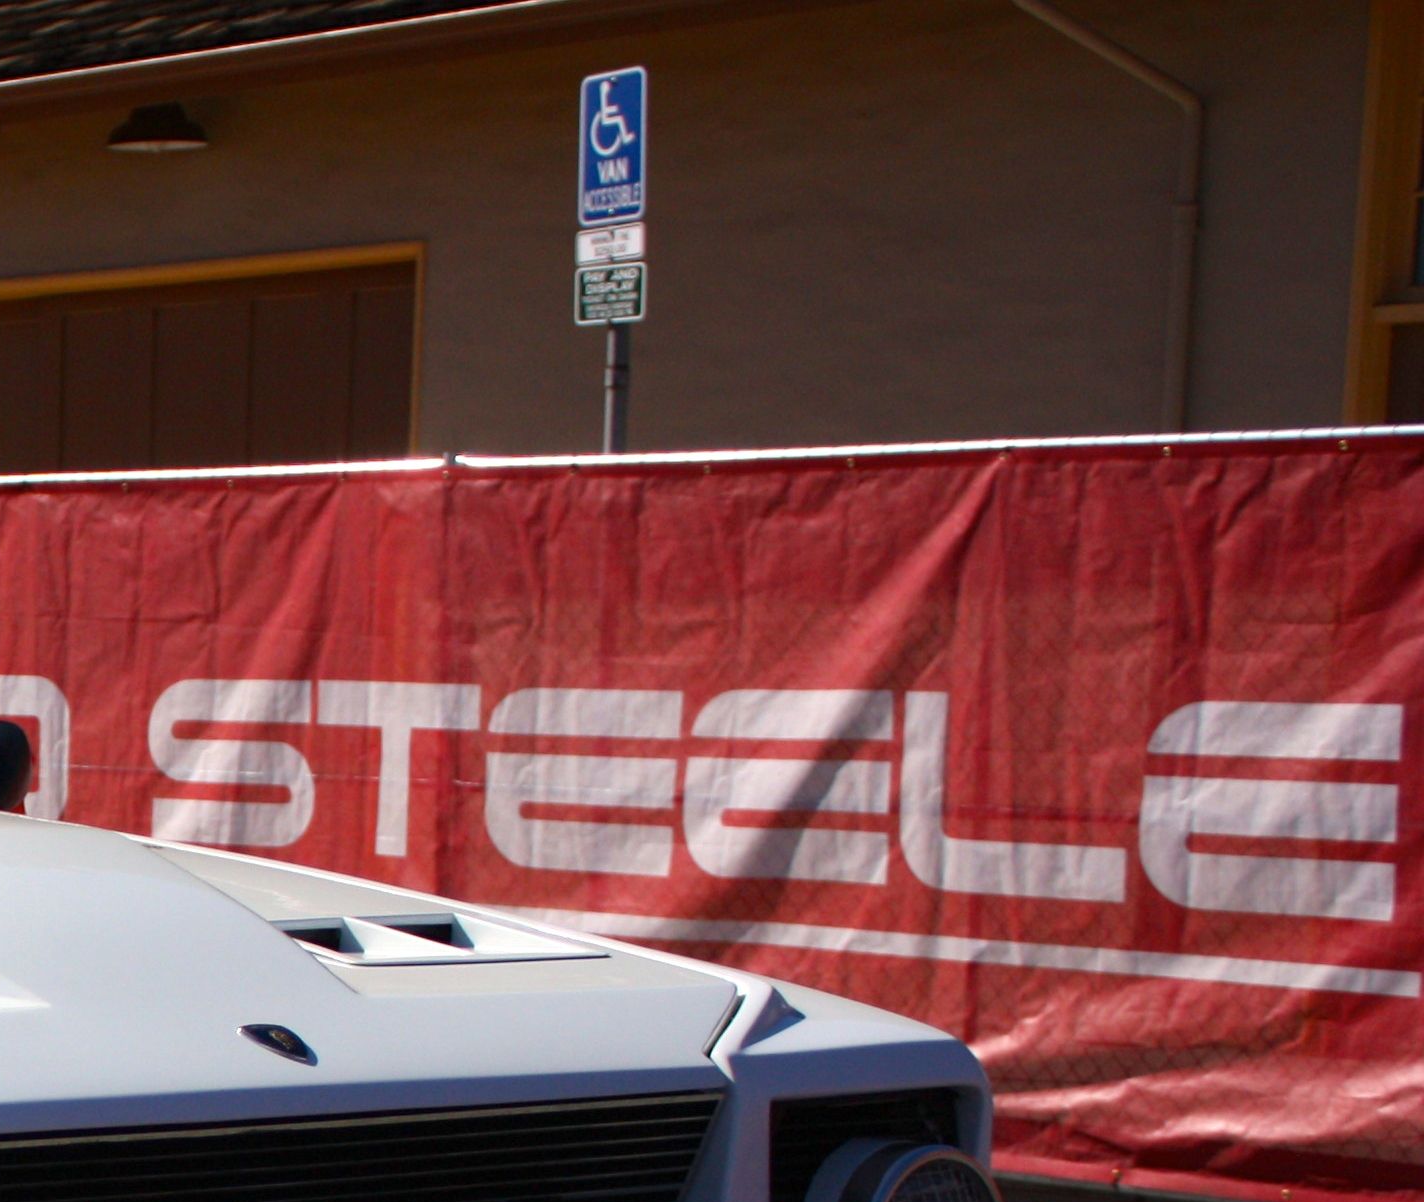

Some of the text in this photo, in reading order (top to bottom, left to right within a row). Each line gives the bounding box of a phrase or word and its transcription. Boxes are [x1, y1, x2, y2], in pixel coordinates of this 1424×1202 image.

[597, 157, 629, 184] VAN
[610, 267, 640, 281] AND
[585, 279, 635, 295] DISPLAY
[147, 677, 1403, 921] STEELE
